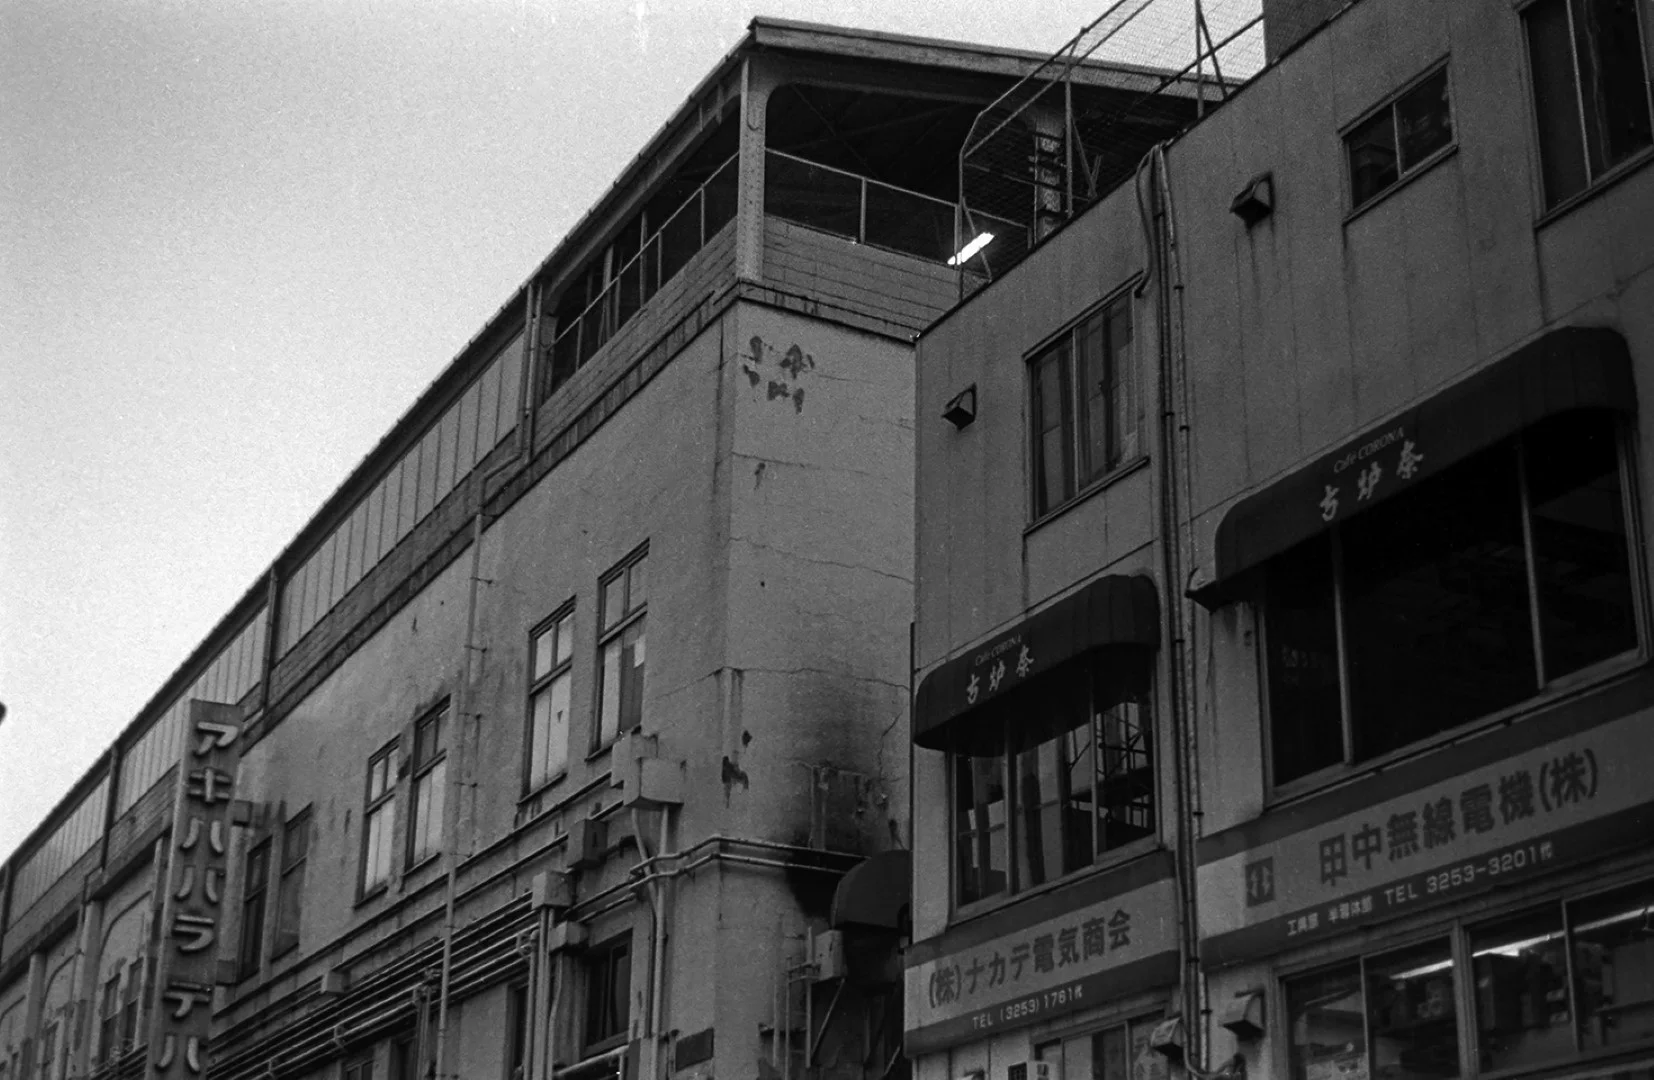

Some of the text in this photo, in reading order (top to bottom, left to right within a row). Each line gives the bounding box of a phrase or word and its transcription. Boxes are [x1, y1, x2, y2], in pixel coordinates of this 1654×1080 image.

[1318, 748, 1598, 886] 田中無線電機(株)
[1384, 881, 1419, 906] TEL
[972, 1014, 994, 1031] TEL
